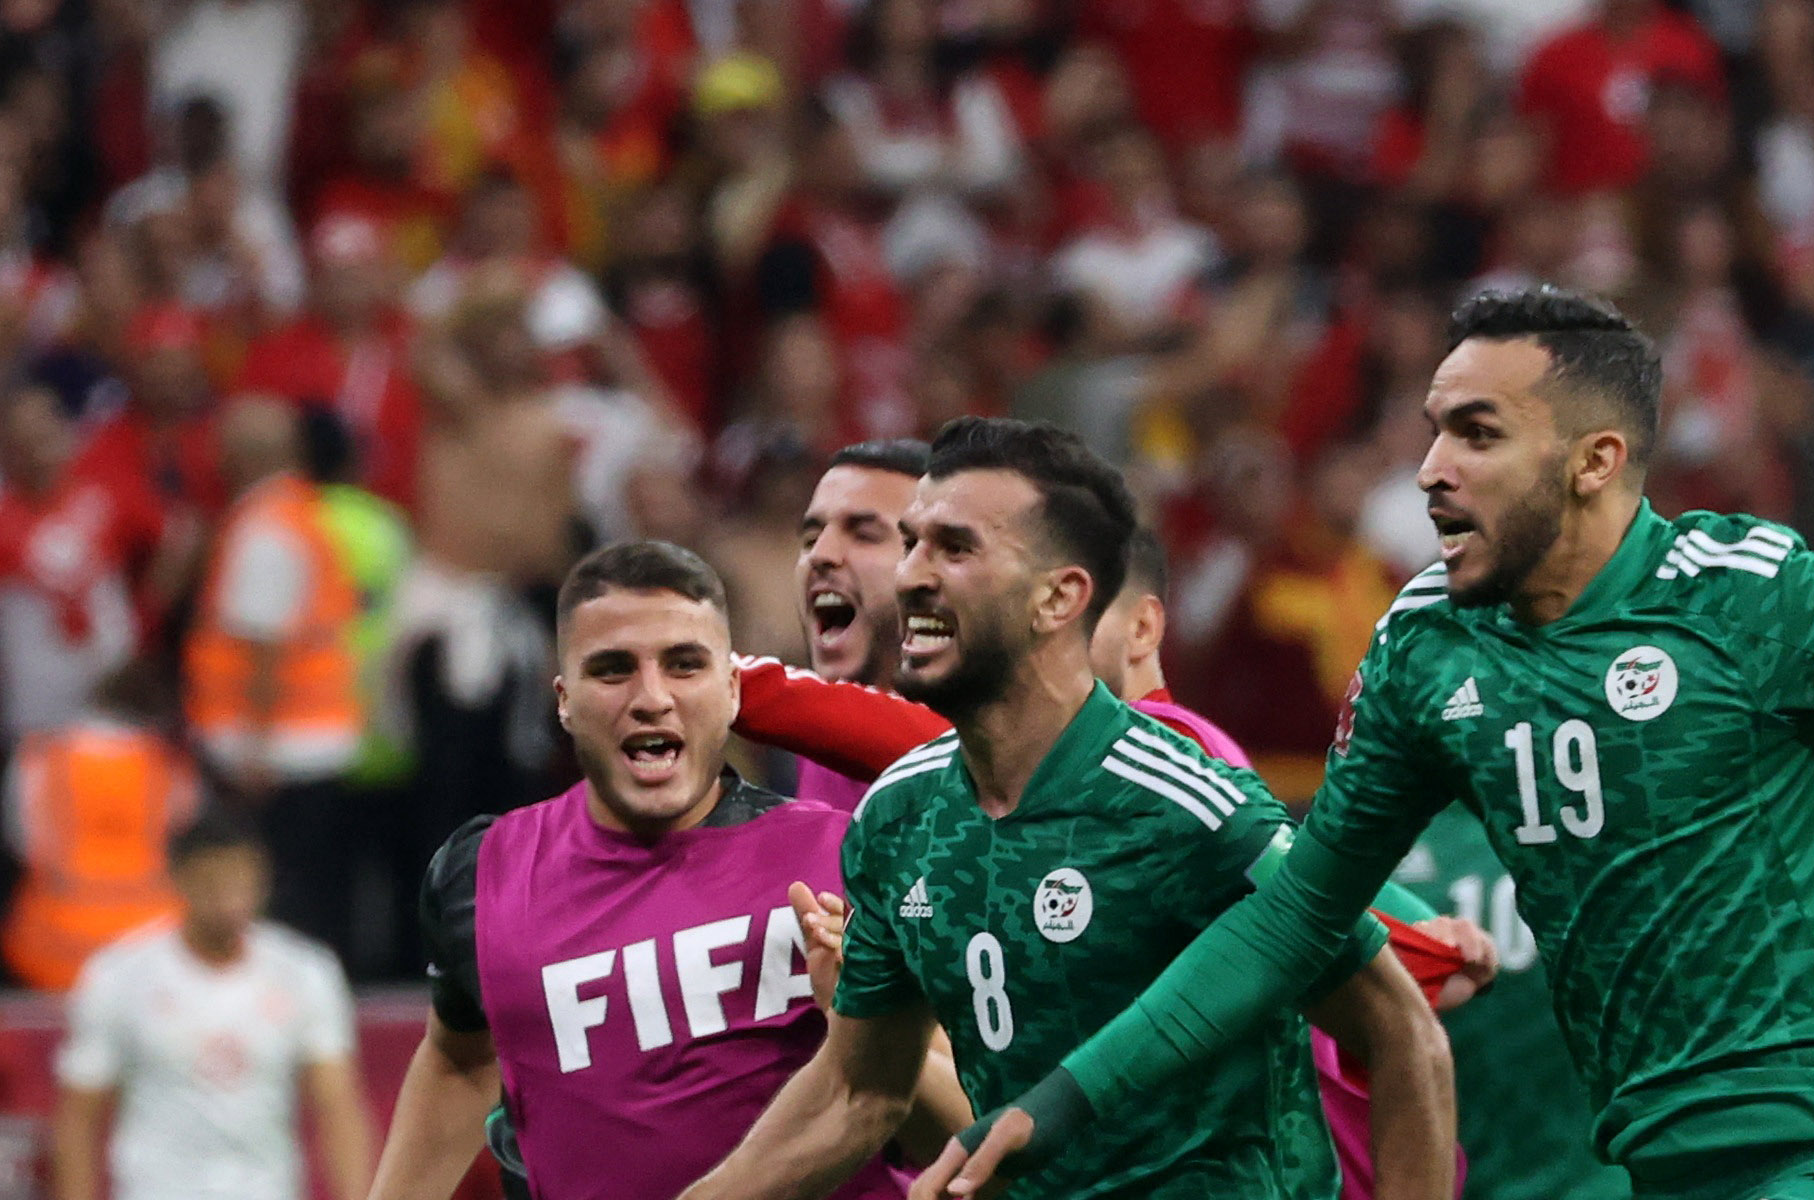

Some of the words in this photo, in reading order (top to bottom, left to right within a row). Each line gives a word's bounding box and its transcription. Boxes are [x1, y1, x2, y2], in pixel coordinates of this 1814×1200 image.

[1504, 718, 1604, 844] 19
[541, 905, 815, 1074] FIFA
[966, 931, 1014, 1052] 8
